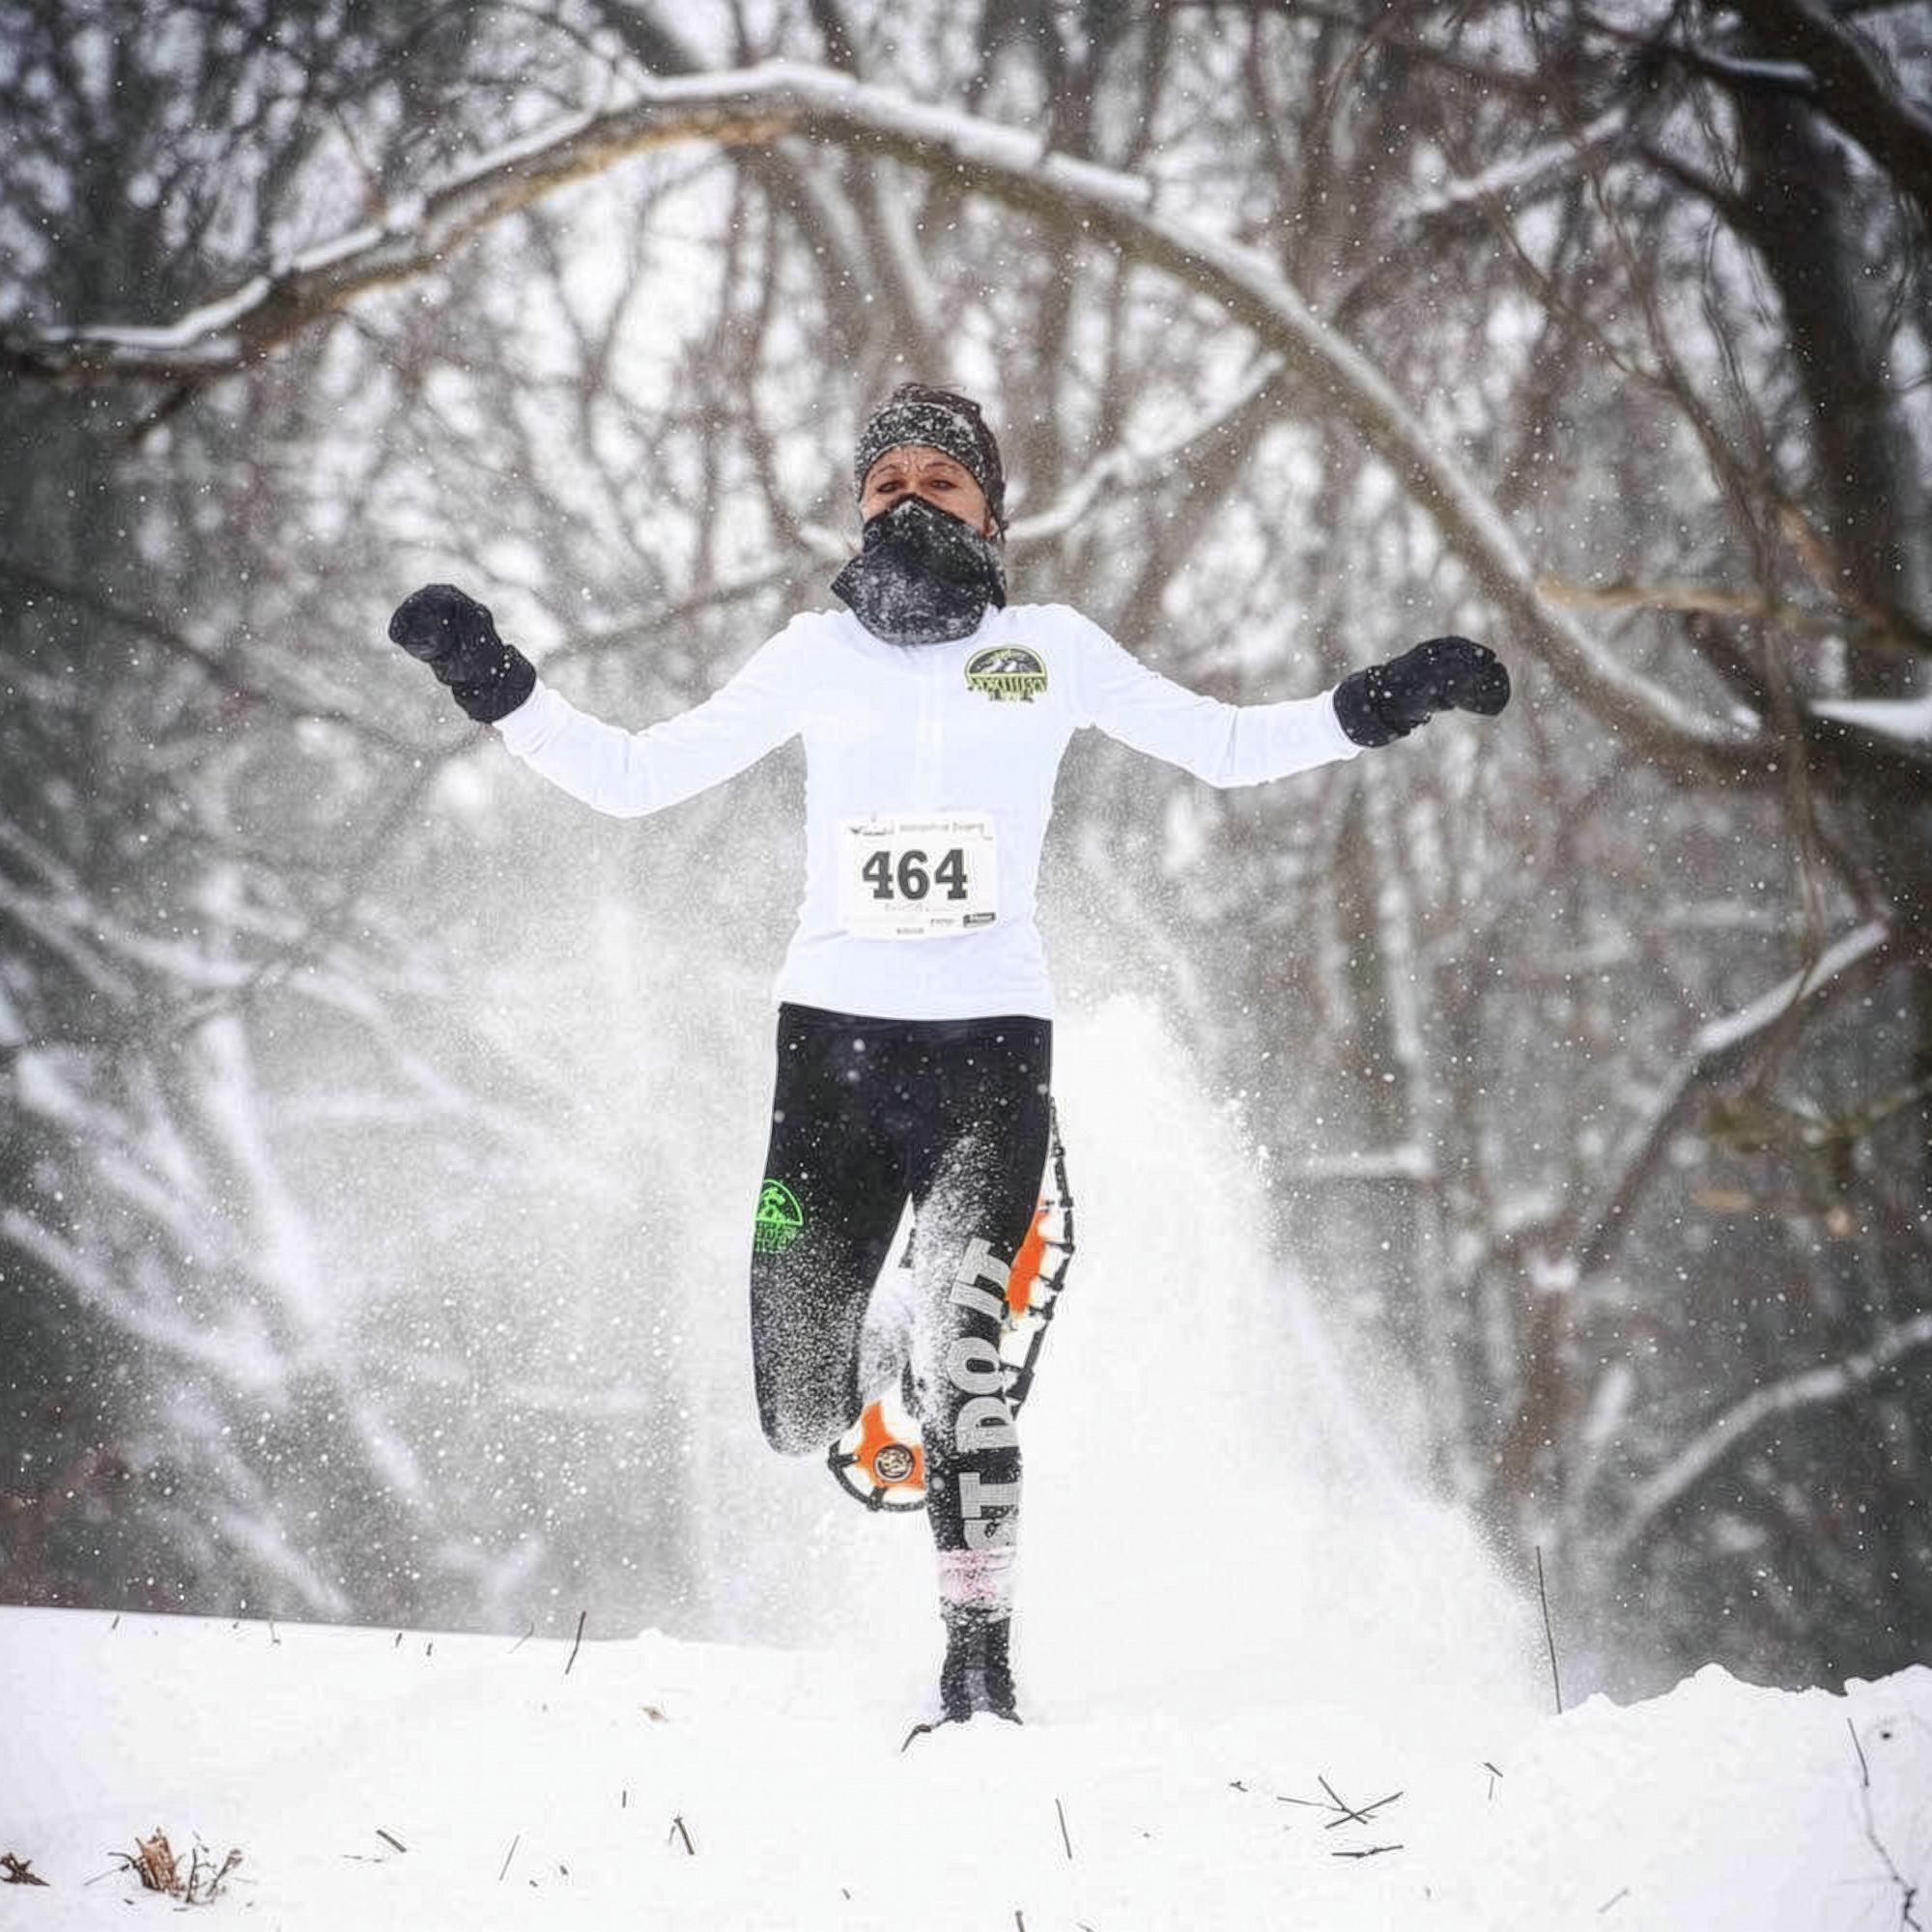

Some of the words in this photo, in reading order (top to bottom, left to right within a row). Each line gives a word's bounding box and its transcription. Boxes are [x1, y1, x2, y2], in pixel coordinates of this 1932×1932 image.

[863, 849, 967, 900] 464
[947, 1236, 1010, 1324] IT
[947, 1337, 1019, 1452] DO
